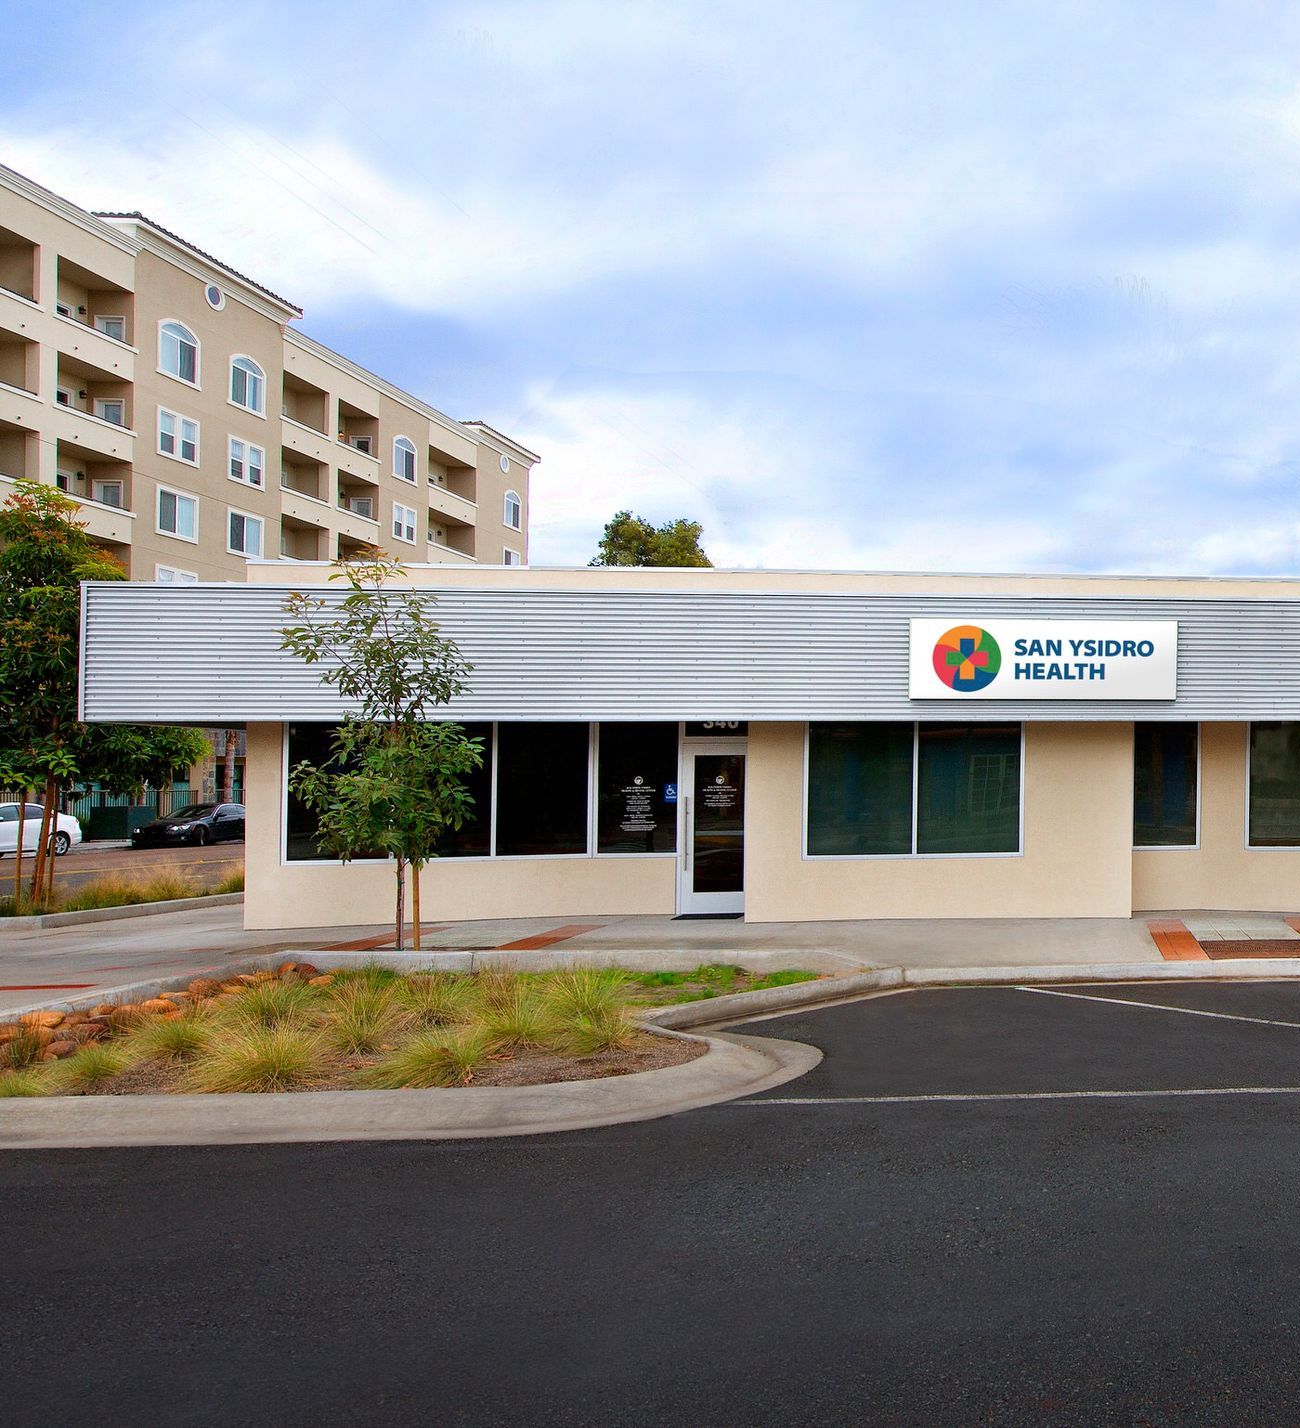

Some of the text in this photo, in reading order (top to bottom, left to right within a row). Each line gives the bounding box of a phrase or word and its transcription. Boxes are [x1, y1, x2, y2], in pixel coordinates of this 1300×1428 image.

[1014, 639, 1155, 658] SAN YSIDRO
[1014, 663, 1106, 680] HEALTH
